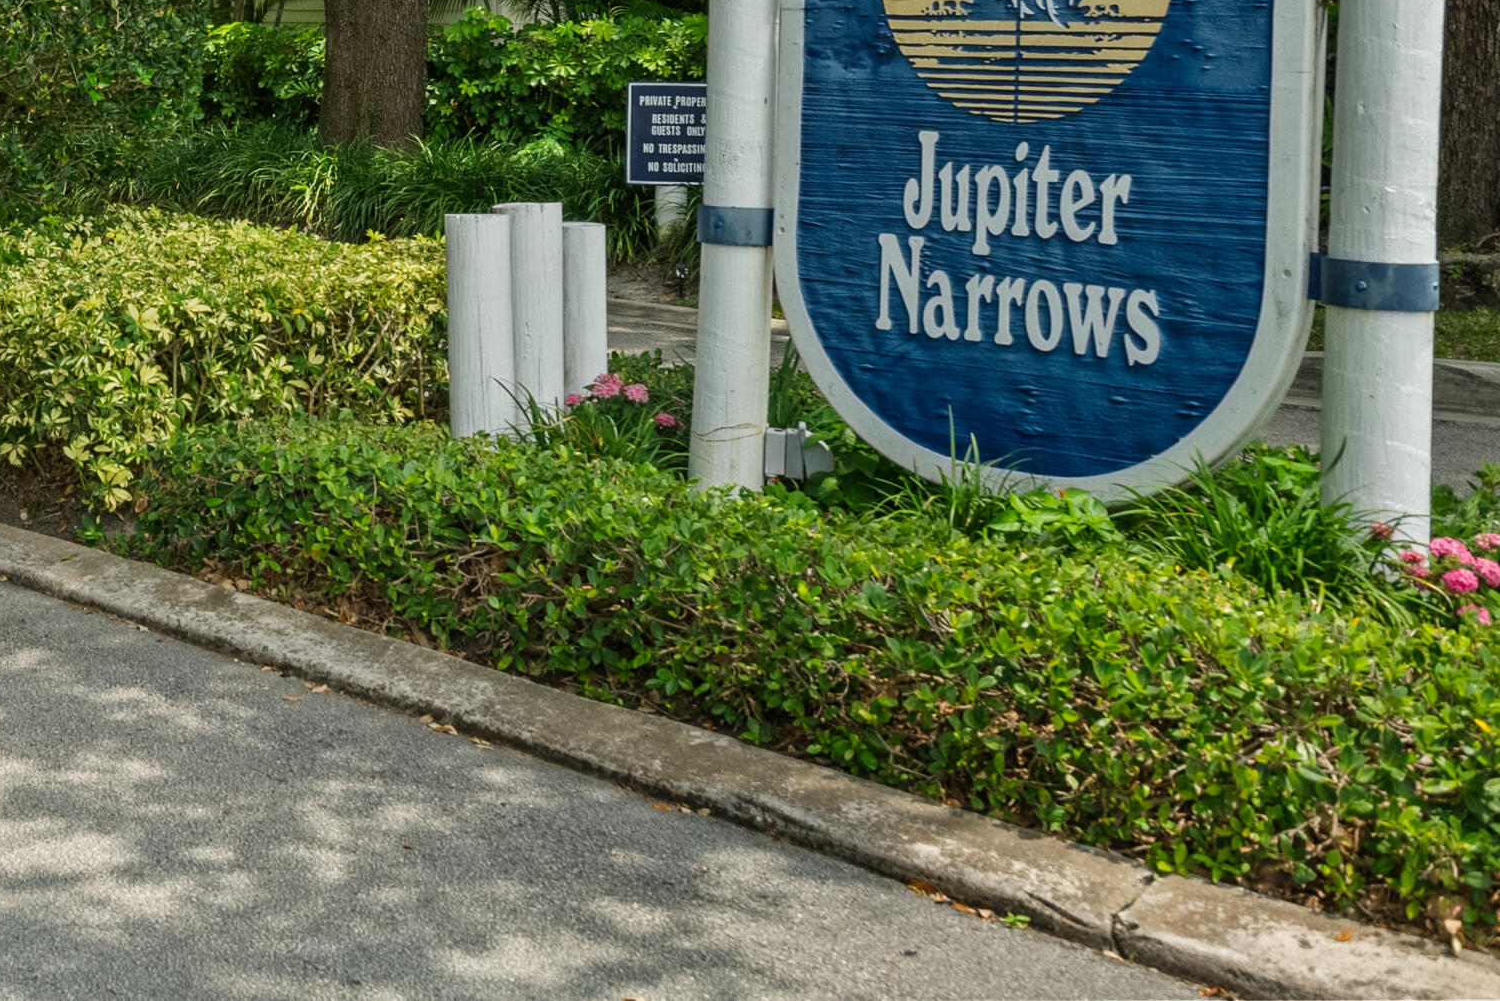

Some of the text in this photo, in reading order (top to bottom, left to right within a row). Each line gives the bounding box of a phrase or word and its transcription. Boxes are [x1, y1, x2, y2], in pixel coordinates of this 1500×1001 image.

[639, 95, 707, 107] PRIVATE PROPER
[652, 114, 706, 124] RESIDENTS &
[651, 125, 706, 136] GUESTS ONLY
[643, 143, 706, 154] NO TRESPASSIN
[648, 162, 705, 173] NO SOLICITIN
[903, 130, 1132, 255] Jupiter
[875, 233, 1162, 366] Narrows
